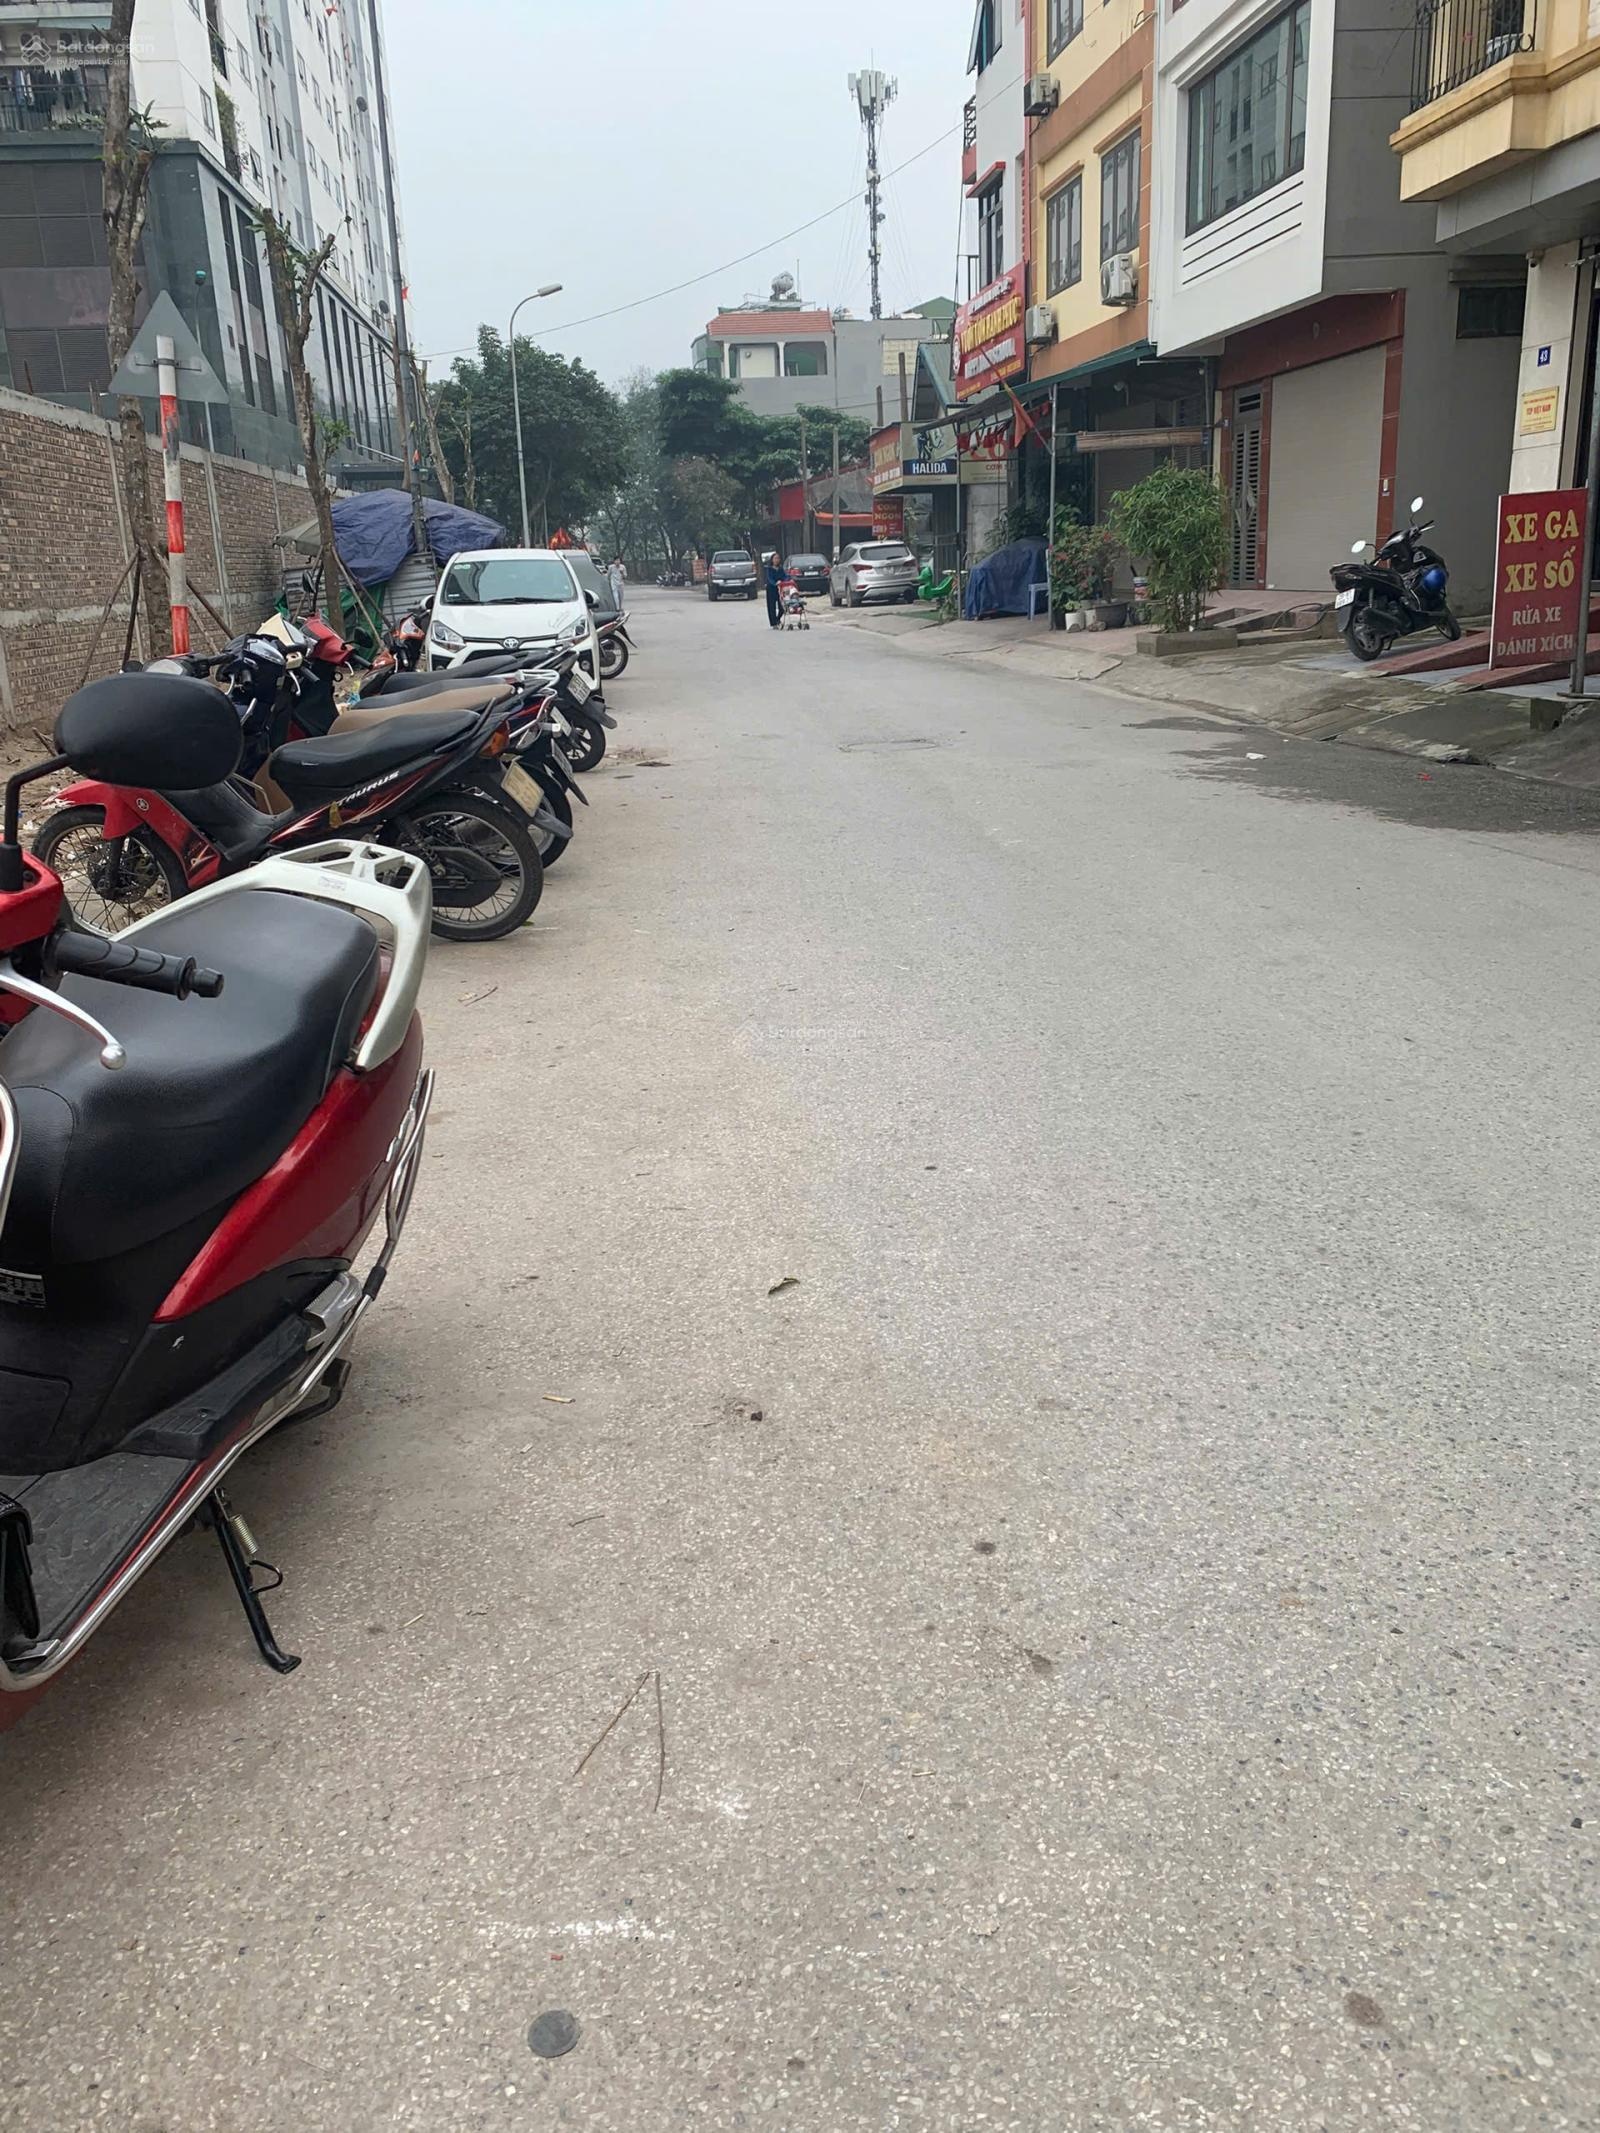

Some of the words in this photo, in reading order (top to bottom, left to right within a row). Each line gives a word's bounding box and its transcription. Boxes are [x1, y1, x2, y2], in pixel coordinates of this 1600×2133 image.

[912, 462, 947, 474] HALIDA
[1504, 512, 1538, 544] XE
[1544, 509, 1579, 540] GA
[1504, 562, 1538, 593] XE
[1543, 545, 1576, 589] SỐ
[1512, 604, 1541, 626] RỬA
[1544, 606, 1561, 623] XE
[1540, 632, 1574, 652] XÍCH
[336, 770, 400, 807] TAURUS
